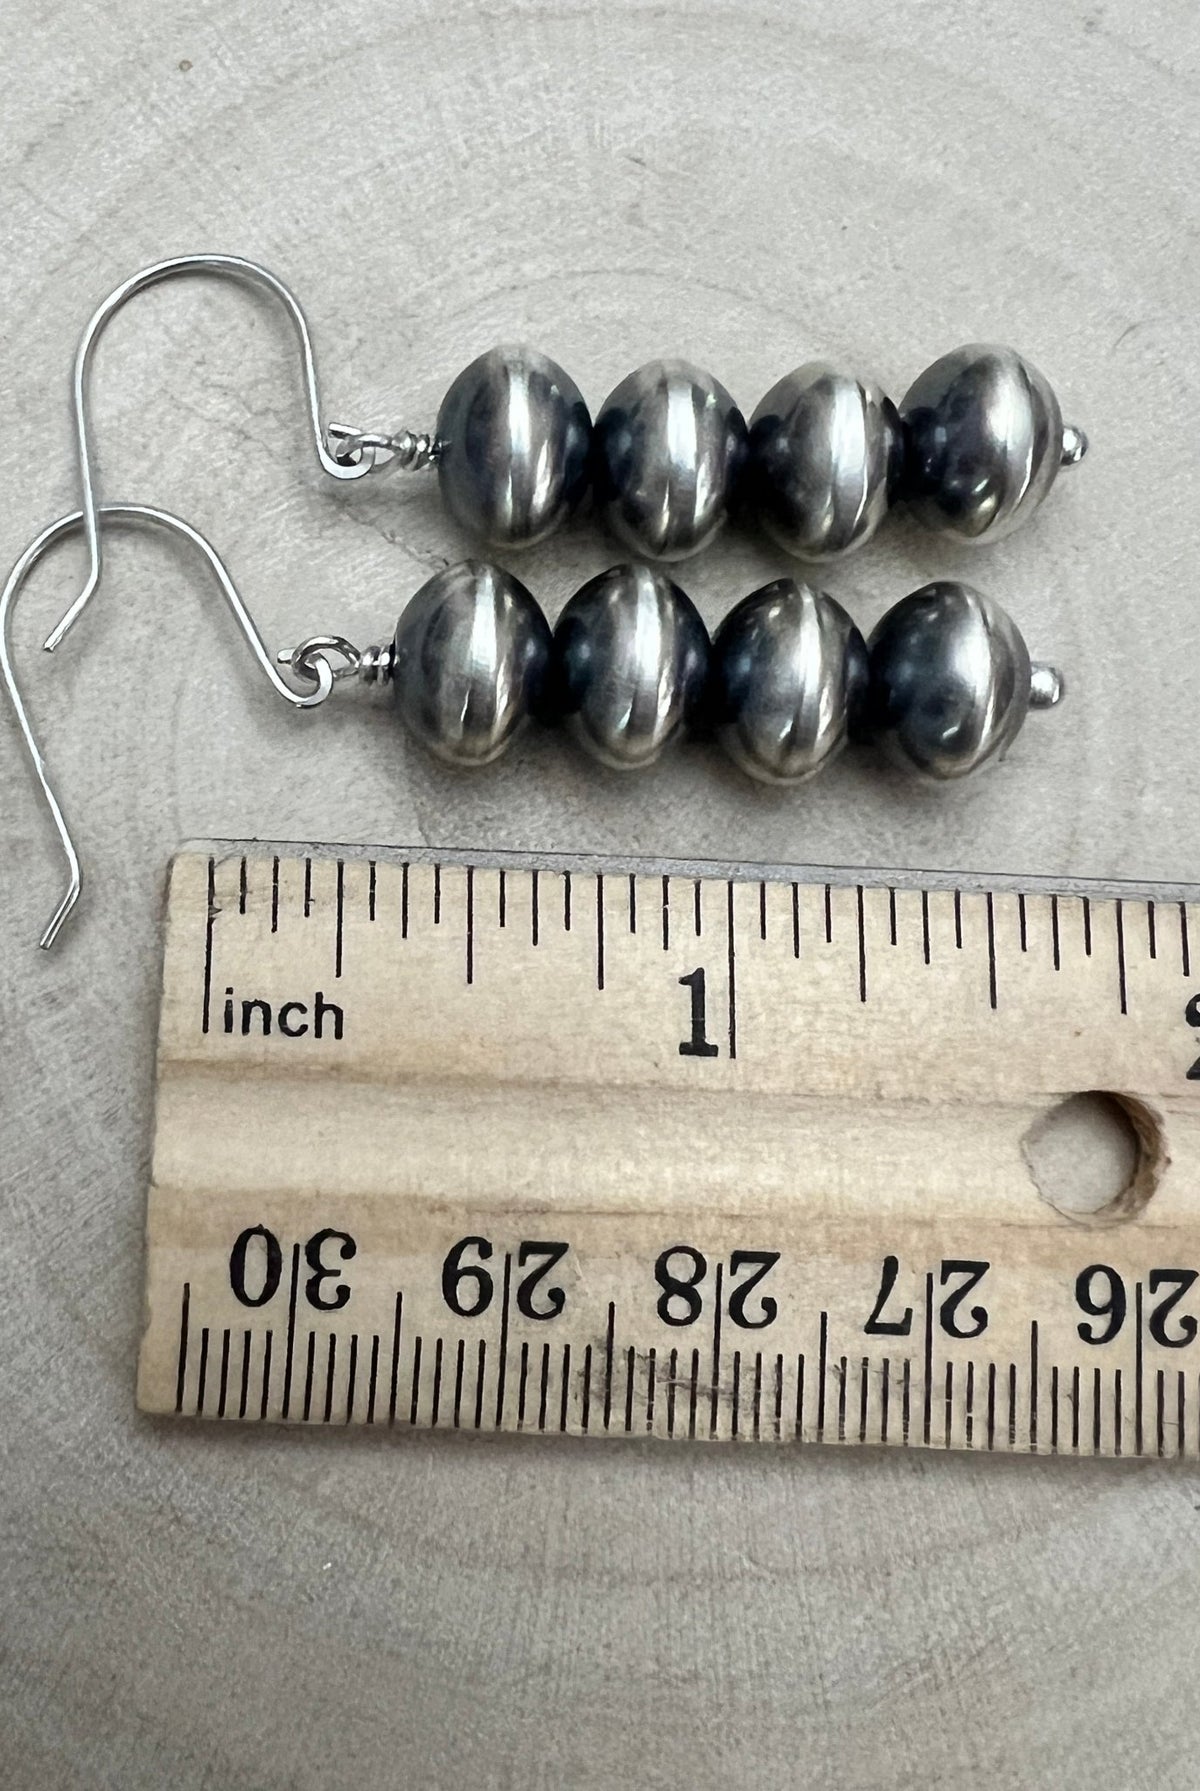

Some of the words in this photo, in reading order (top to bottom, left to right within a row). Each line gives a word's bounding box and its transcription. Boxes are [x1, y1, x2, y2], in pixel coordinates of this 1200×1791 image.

[223, 987, 344, 1040] inch
[678, 967, 719, 1058] 1
[228, 1223, 357, 1311] 30
[441, 1235, 570, 1321] 29
[654, 1245, 781, 1329] 28
[863, 1255, 990, 1339] 27
[1075, 1264, 1200, 1349] 26
